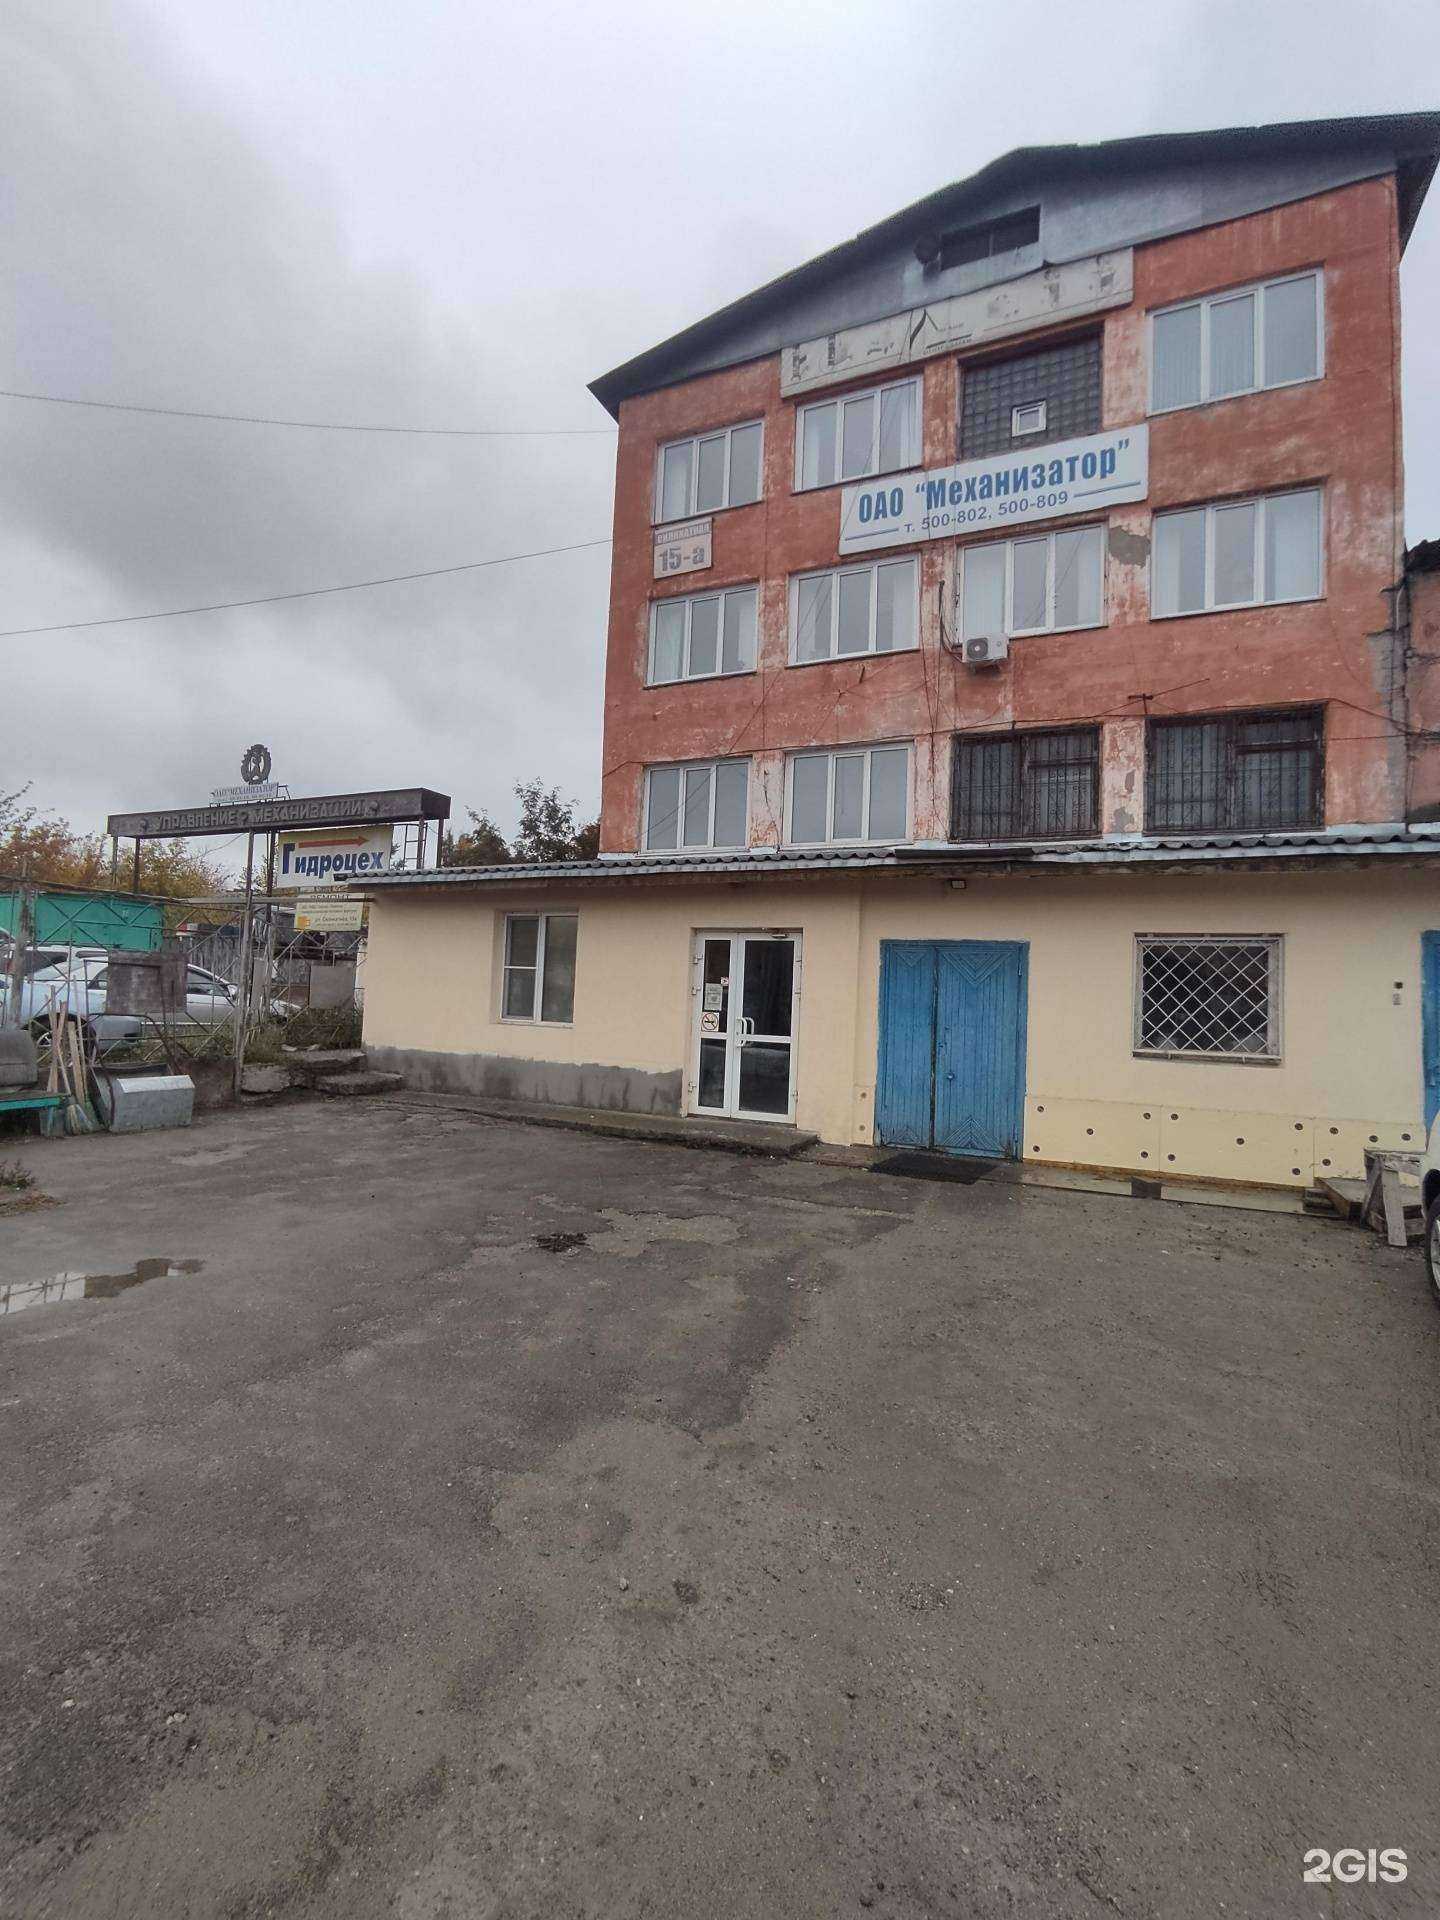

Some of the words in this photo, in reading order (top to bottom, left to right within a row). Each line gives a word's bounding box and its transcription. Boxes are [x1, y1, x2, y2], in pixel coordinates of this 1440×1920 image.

[858, 486, 905, 524] ОАО
[921, 507, 993, 531] 500-802,
[998, 491, 1069, 516] 500-809
[158, 811, 235, 831] УПРАВЛЕНИЕ
[251, 801, 364, 824] МЕХАНИЗАЦИИ
[282, 842, 384, 879] Гидроцех
